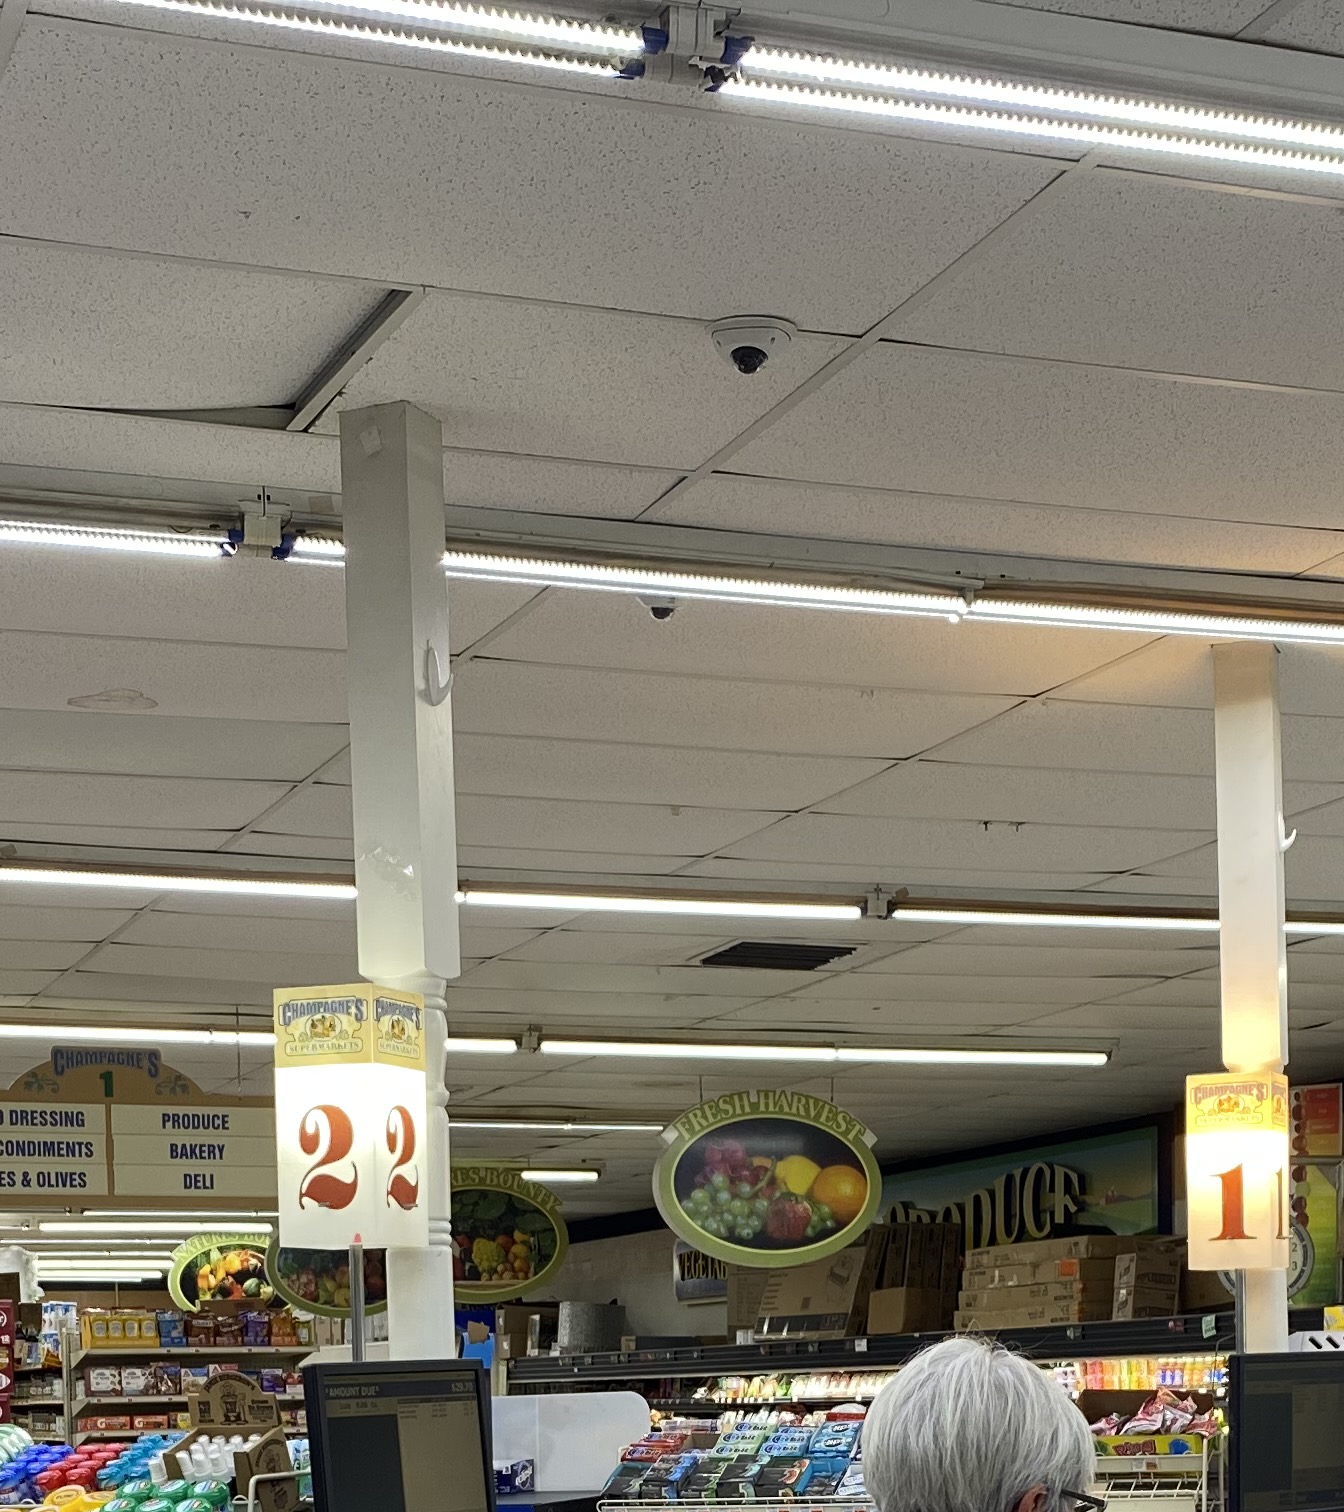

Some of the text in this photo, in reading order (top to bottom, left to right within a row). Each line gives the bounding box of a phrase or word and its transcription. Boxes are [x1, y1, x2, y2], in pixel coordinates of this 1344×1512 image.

[282, 998, 364, 1027] CHAMPAGNE'S
[289, 1041, 360, 1052] SUPERMARKETS
[55, 1050, 159, 1078] CHAMPAGNE'S
[99, 1071, 113, 1097] 1
[1194, 1083, 1266, 1105] CHAMPAGNE'S
[9, 1110, 85, 1128] DRESSING
[161, 1113, 229, 1130] PRODUCE
[675, 1090, 866, 1142] FRESH HARVEST
[169, 1143, 225, 1160] BAKERY
[299, 1104, 358, 1210] 2
[386, 1105, 419, 1210] 2
[21, 1171, 32, 1188] &
[36, 1172, 87, 1189] OLIVES
[183, 1173, 214, 1190] DELI
[487, 1168, 564, 1211] BOUNTY
[1208, 1162, 1257, 1241] 1
[1291, 1243, 1298, 1253] 2
[1291, 1261, 1298, 1271] 3
